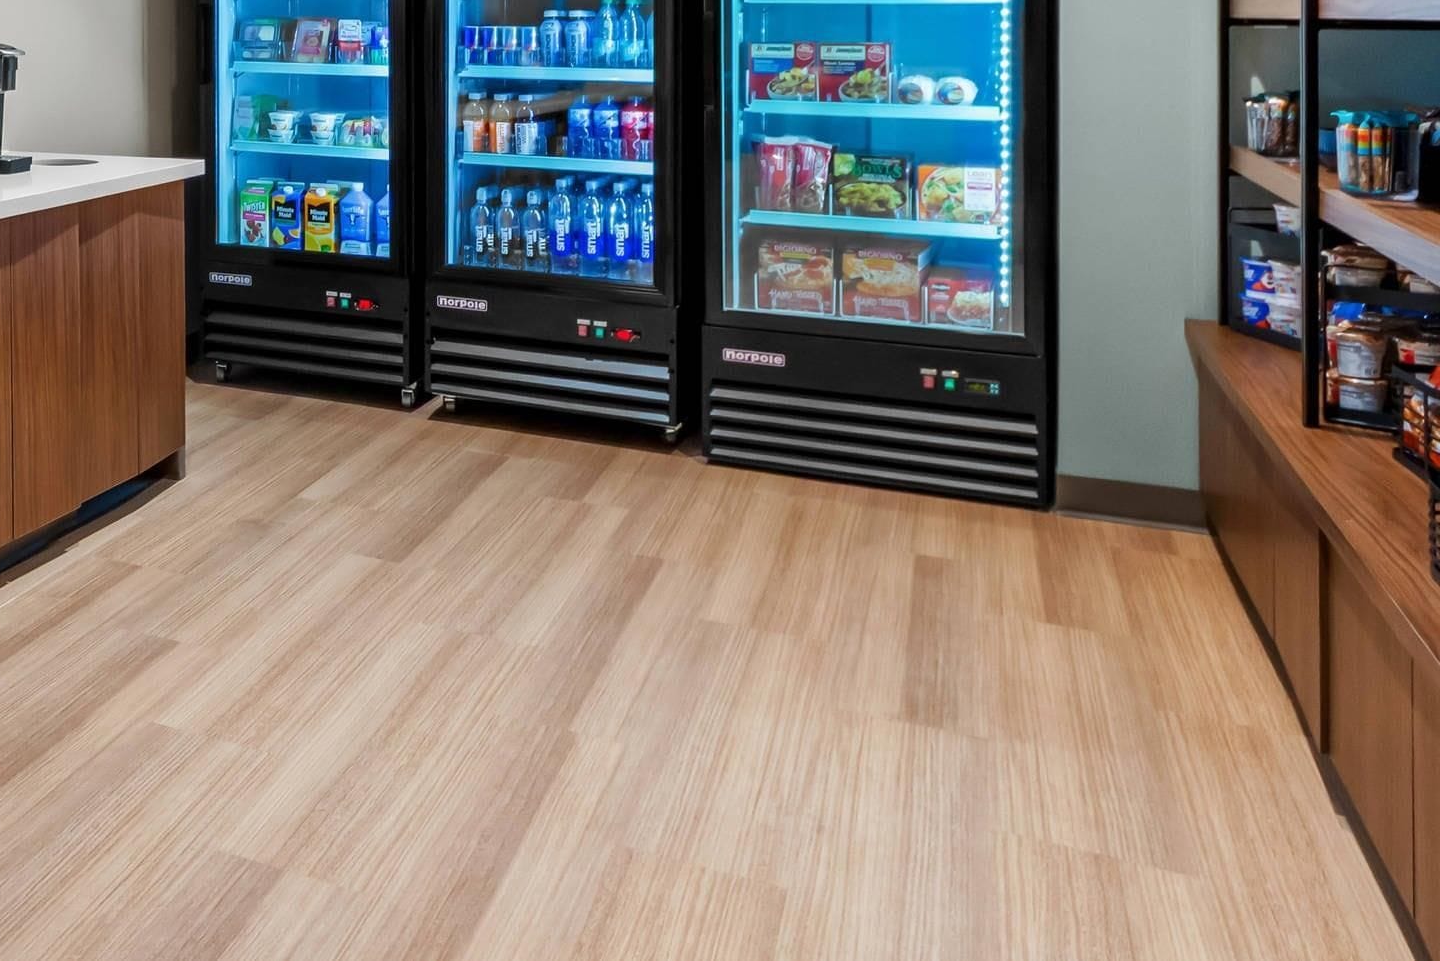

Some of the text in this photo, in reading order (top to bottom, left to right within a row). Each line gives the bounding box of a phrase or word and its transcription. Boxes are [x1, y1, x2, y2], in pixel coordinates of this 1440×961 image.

[556, 219, 565, 251] smart
[587, 222, 597, 255] smart
[615, 223, 625, 257] smart
[211, 273, 250, 284] norpole
[439, 296, 486, 310] norpole
[725, 350, 784, 365] norpole
